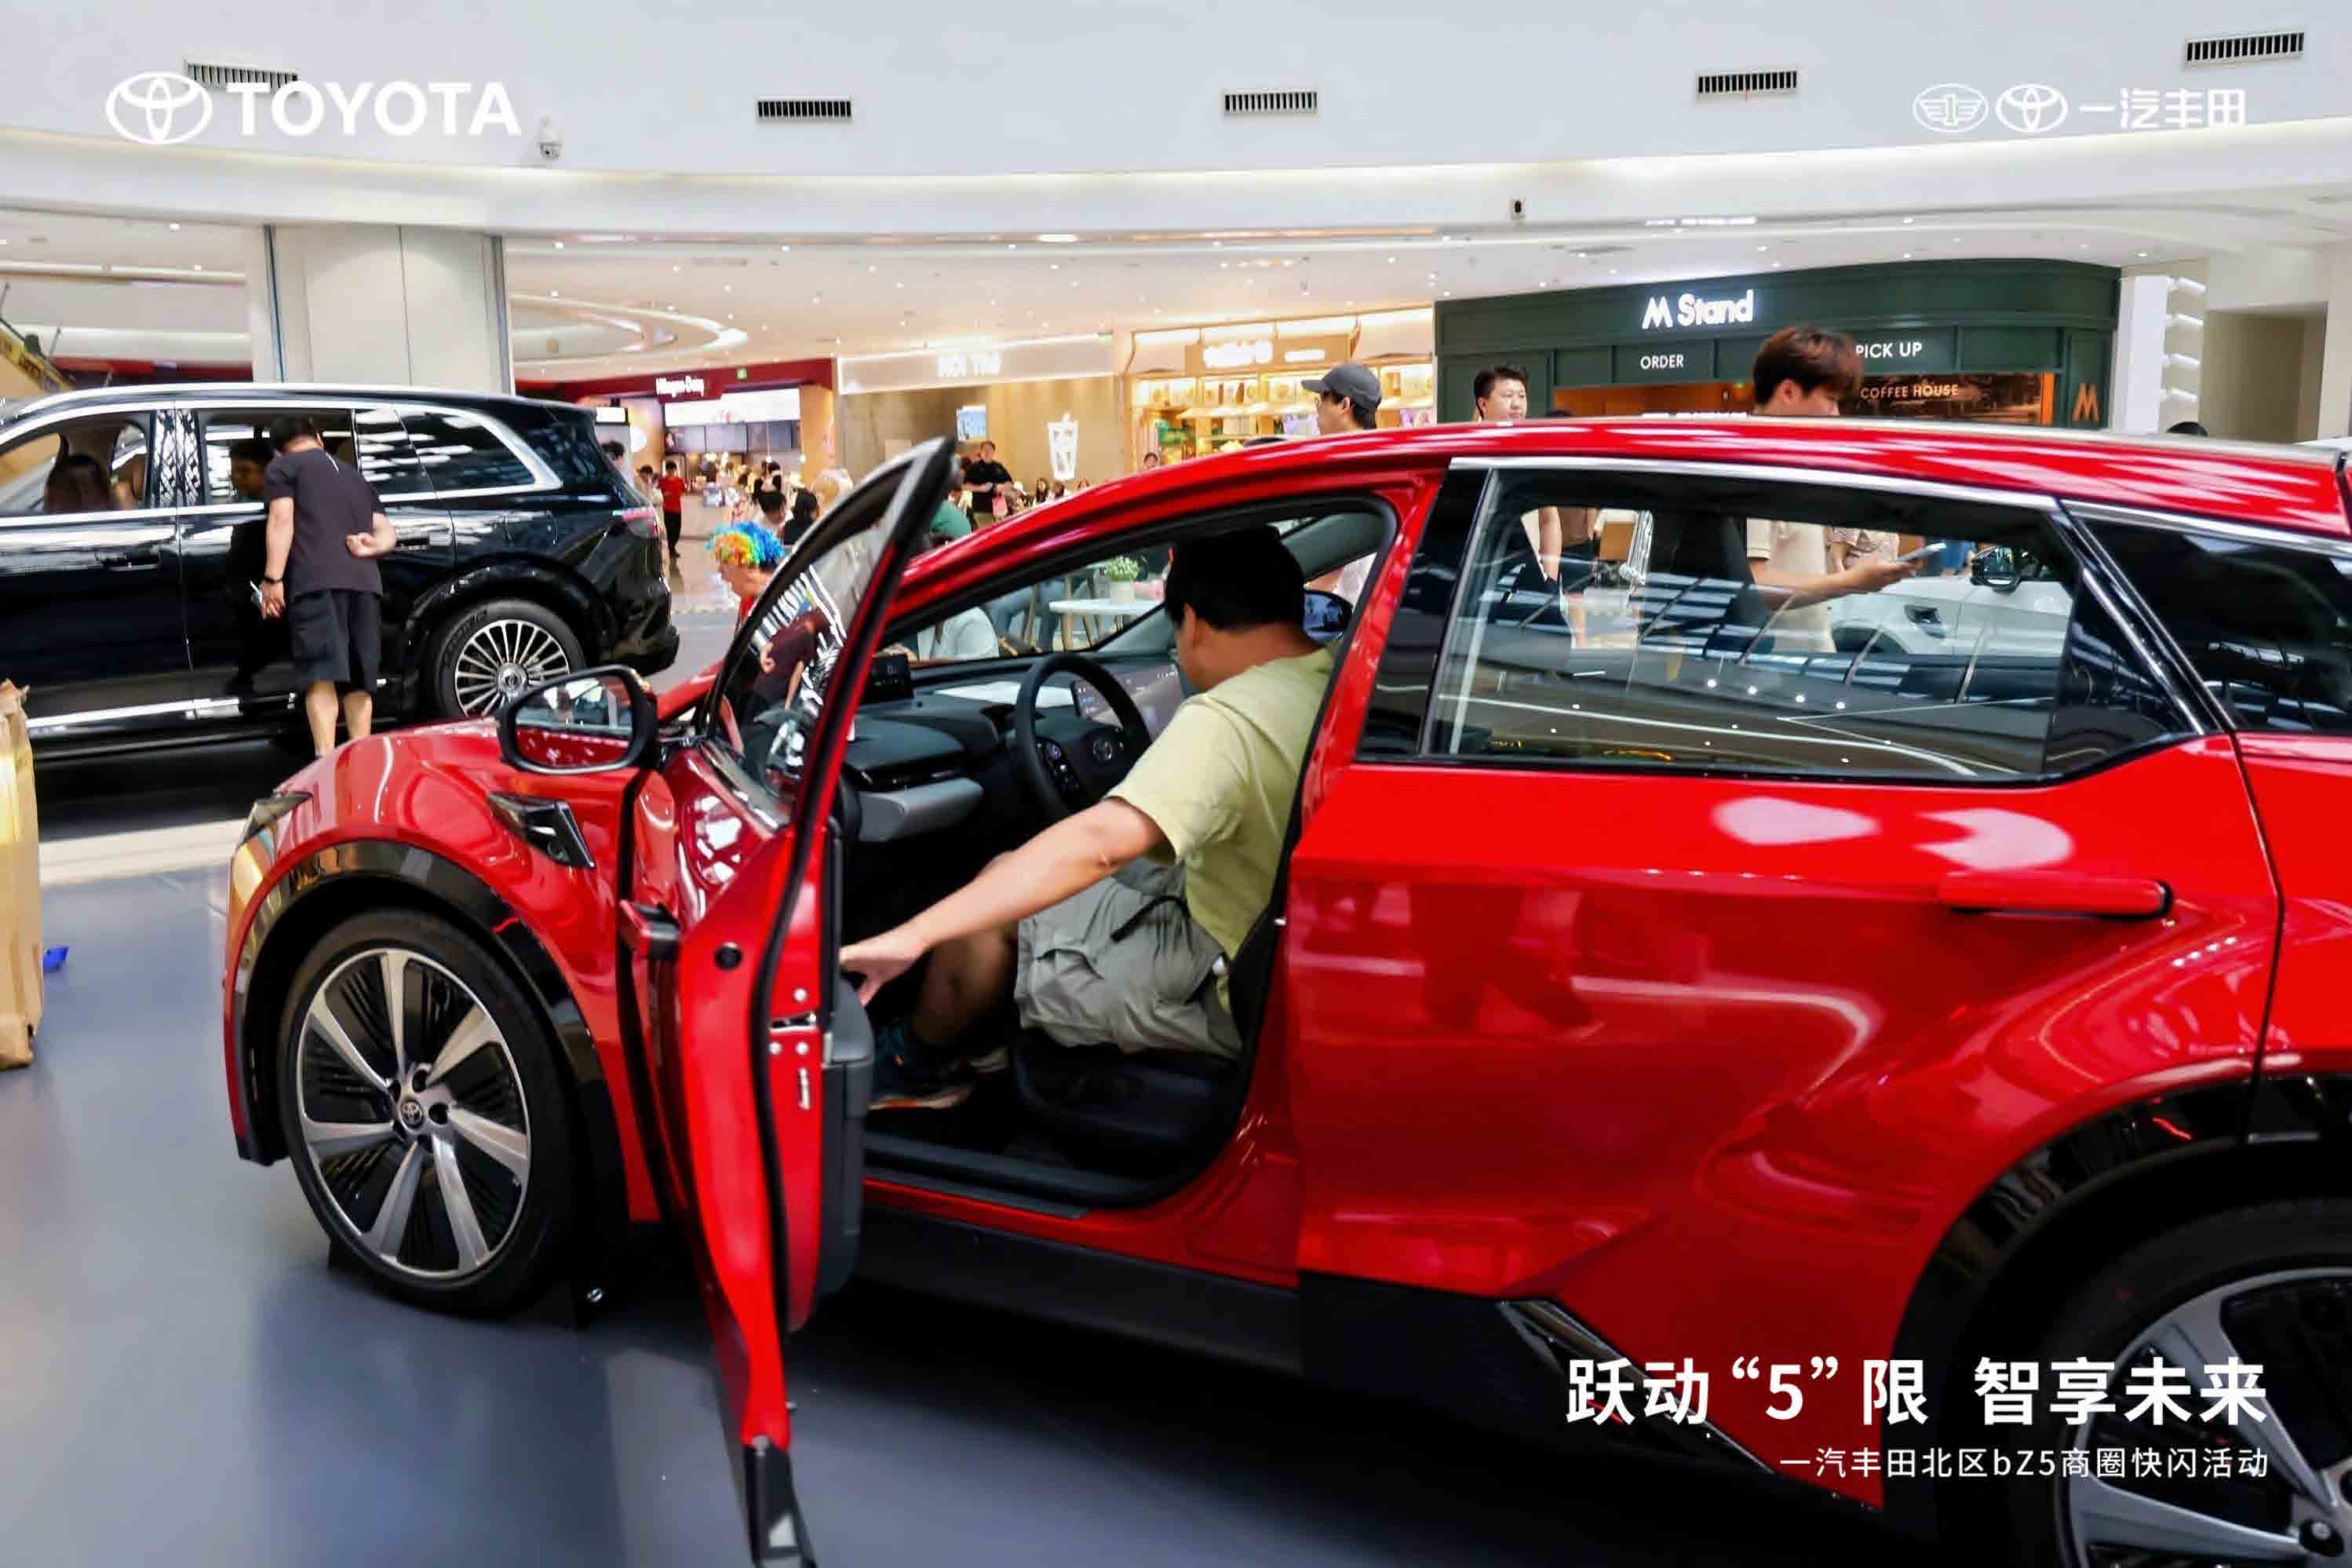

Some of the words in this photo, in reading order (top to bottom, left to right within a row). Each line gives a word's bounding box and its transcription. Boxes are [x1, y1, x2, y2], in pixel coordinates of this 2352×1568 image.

[1642, 296, 1673, 329] M
[1677, 290, 1754, 326] Stand
[1855, 343, 1894, 358] PICK
[1899, 342, 1923, 357] UP
[1639, 353, 1684, 370] ORDER
[1860, 386, 1909, 399] COFFEE
[1913, 384, 1960, 398] HOUSE
